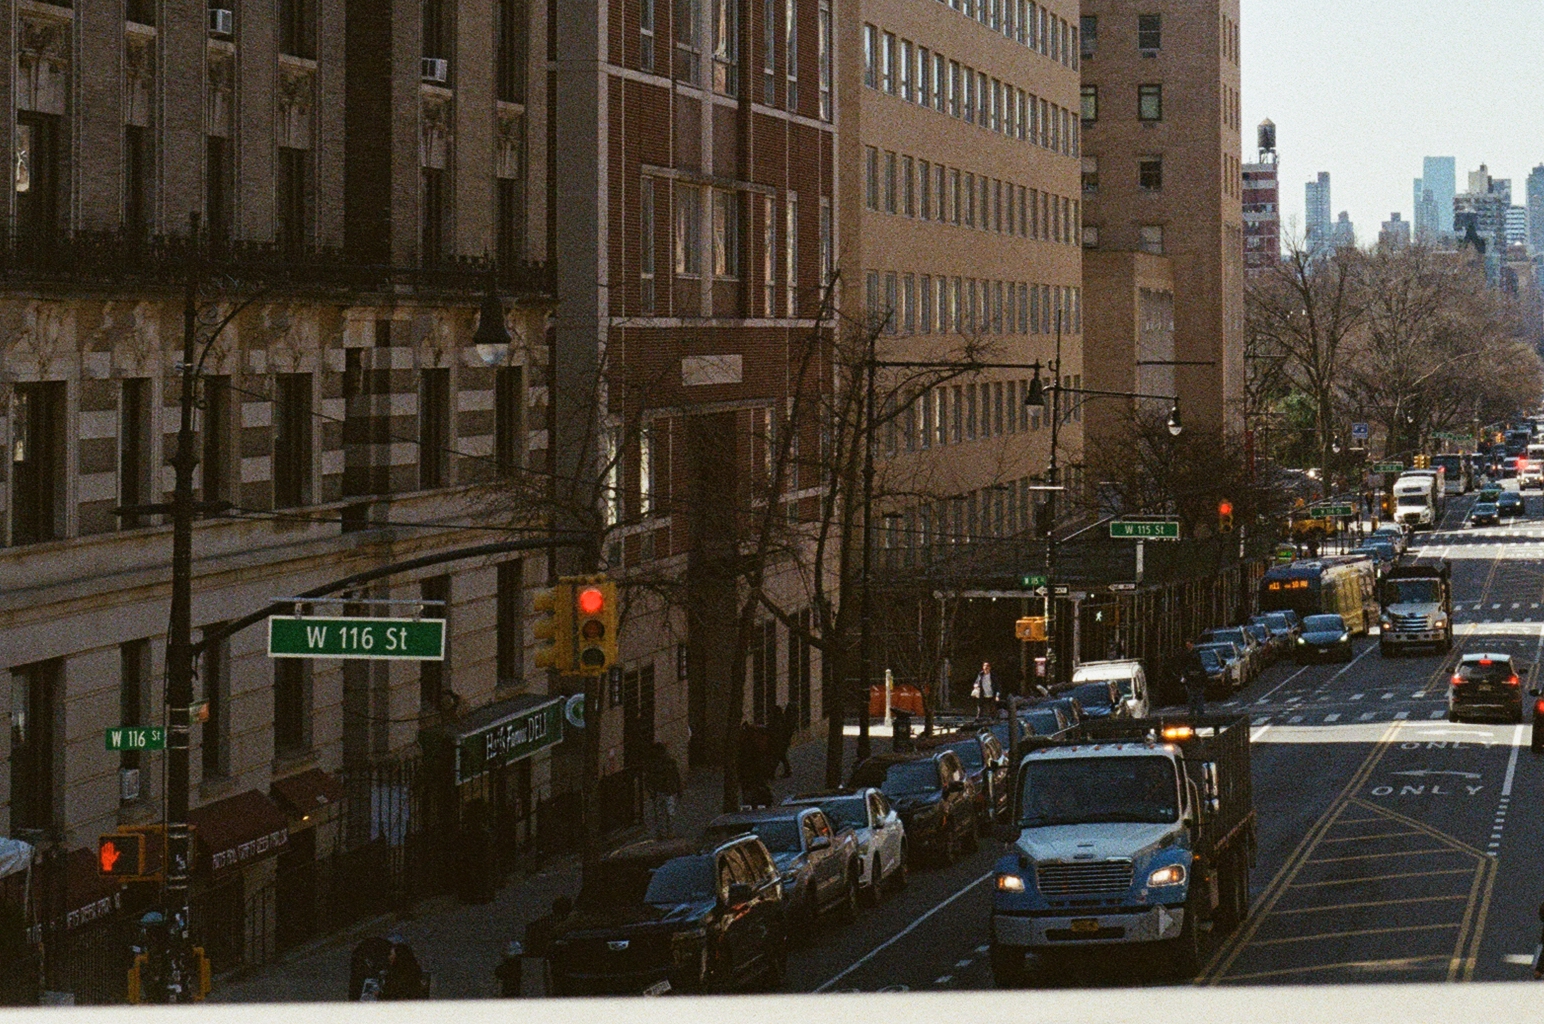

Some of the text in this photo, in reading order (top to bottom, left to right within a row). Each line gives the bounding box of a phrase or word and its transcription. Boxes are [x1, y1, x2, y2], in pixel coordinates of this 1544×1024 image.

[1125, 526, 1165, 535] W 115 St
[306, 626, 408, 650] W 116 St
[528, 712, 547, 743] DELI
[111, 730, 161, 748] W 116 St
[1371, 785, 1484, 796] ONLY
